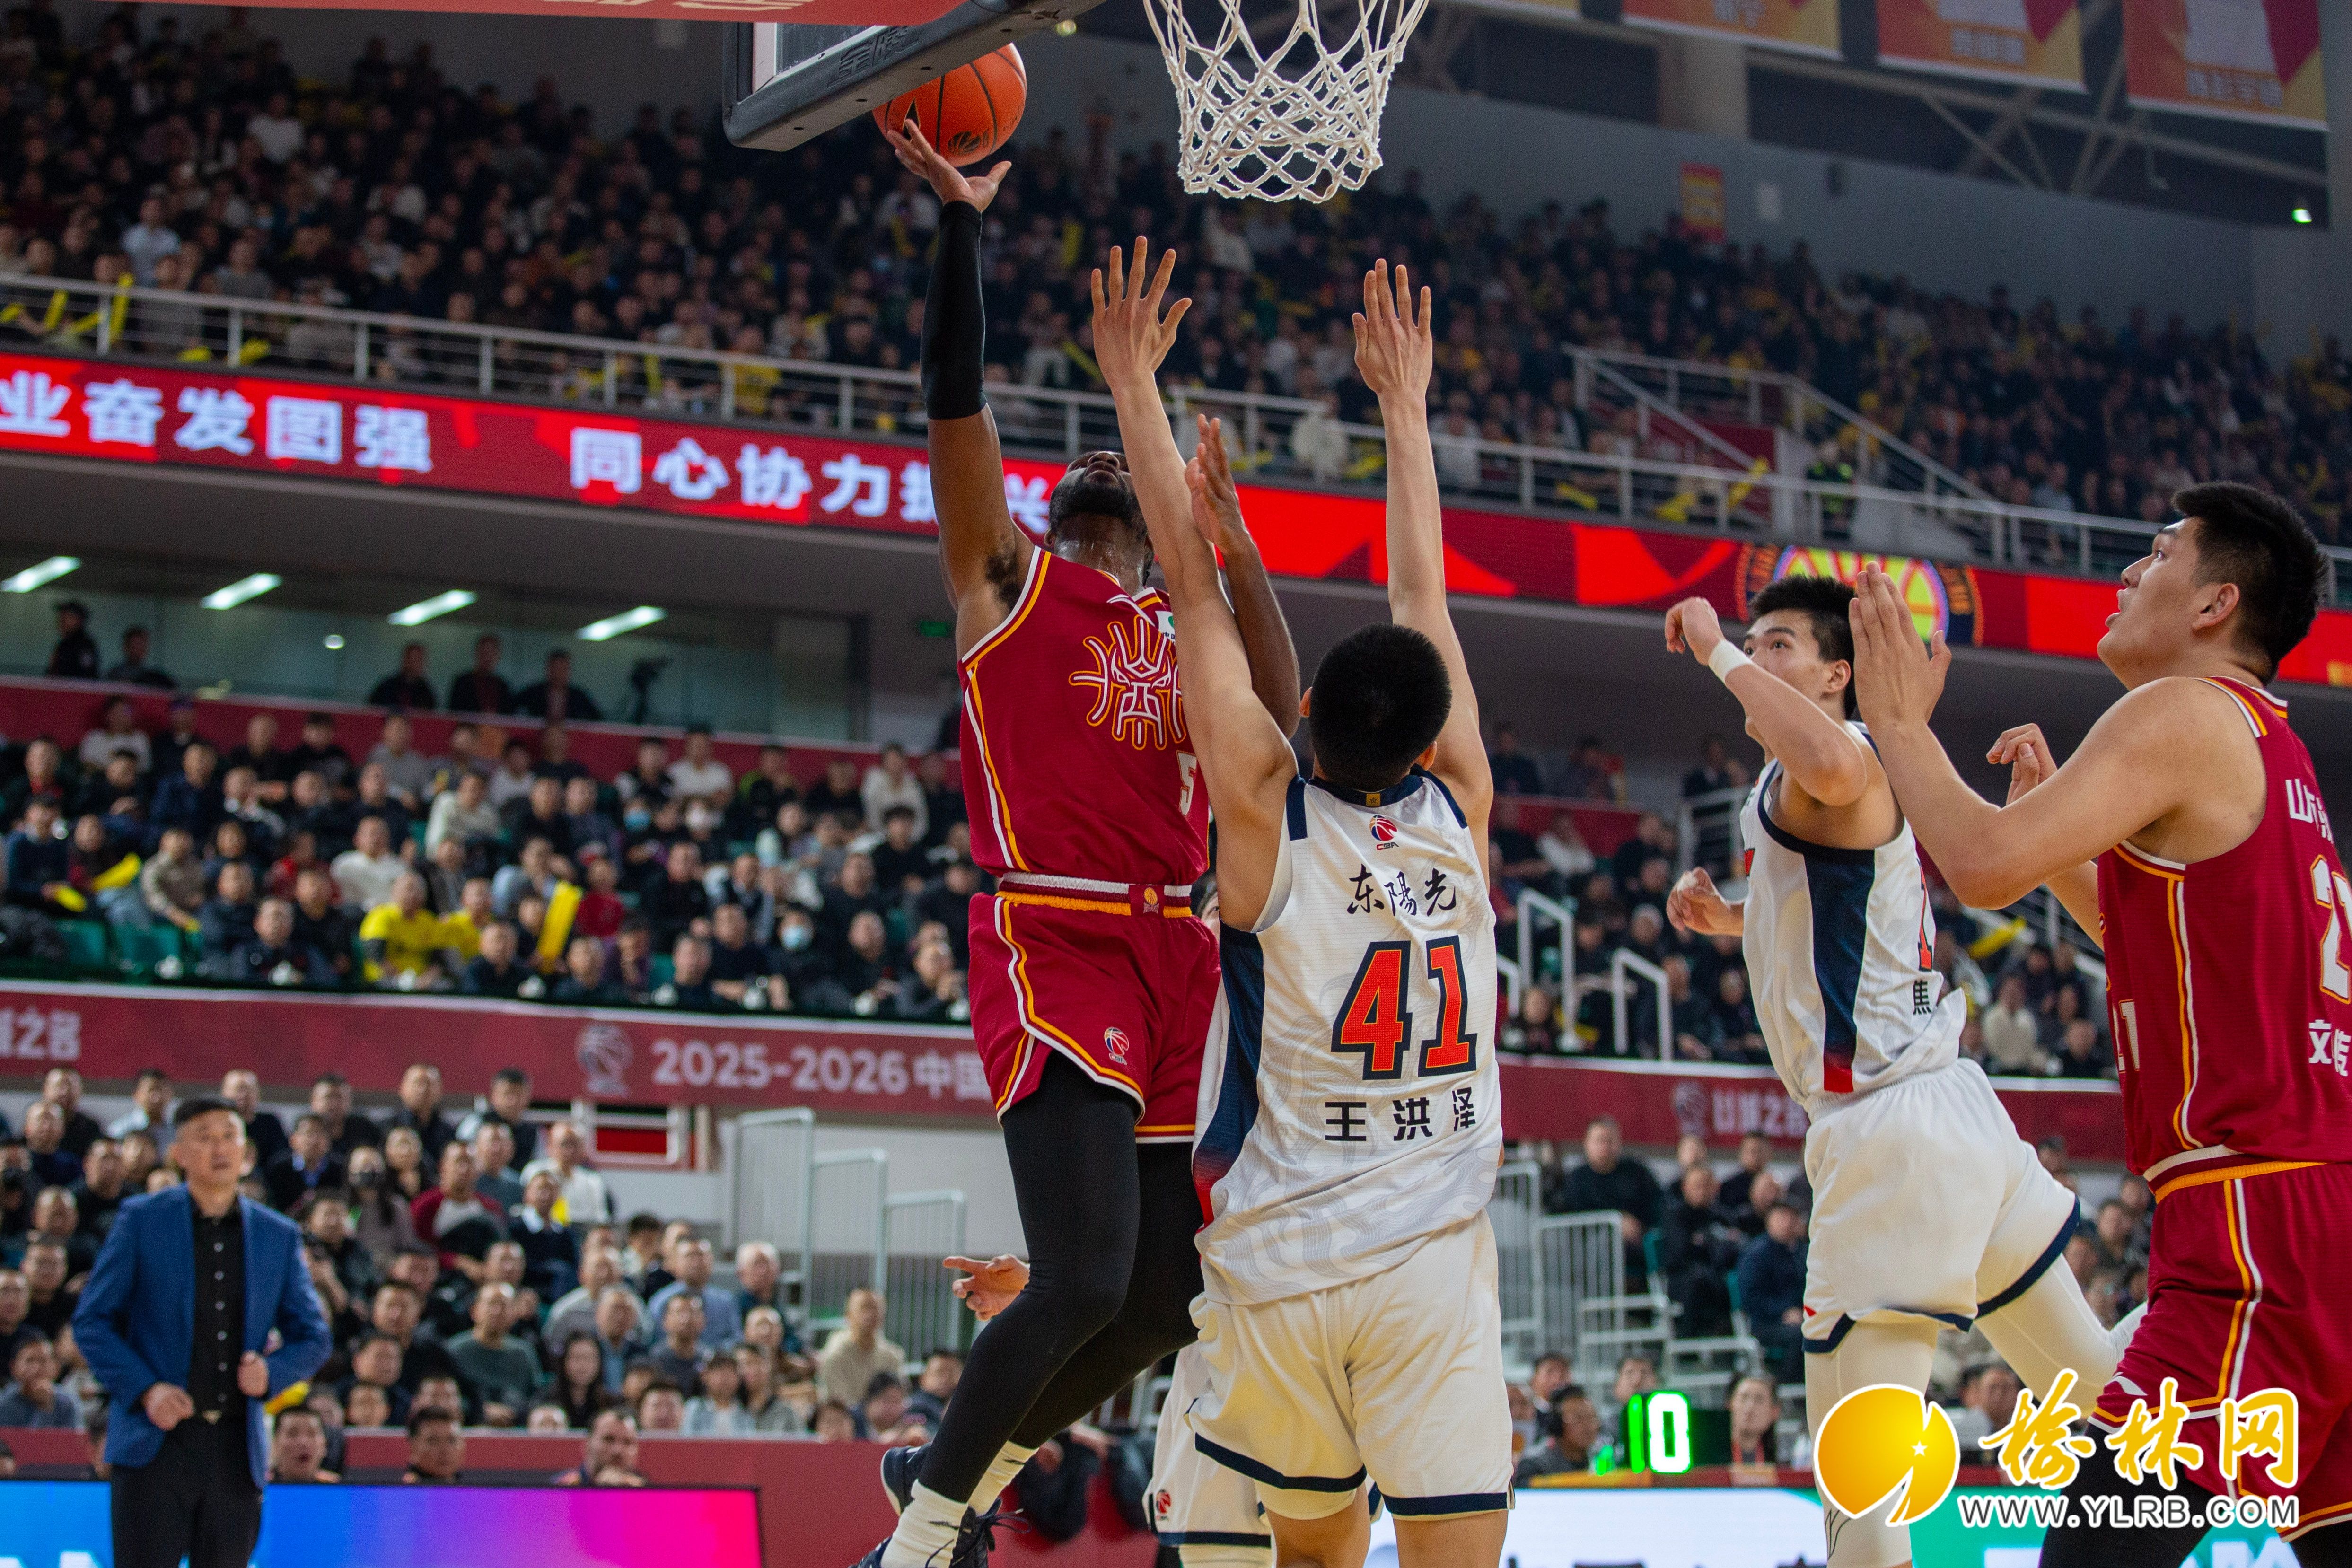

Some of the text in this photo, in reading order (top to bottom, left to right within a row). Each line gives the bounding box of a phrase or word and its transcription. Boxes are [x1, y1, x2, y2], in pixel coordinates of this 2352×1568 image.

[1377, 842, 1399, 850] CBA
[1331, 935, 1476, 1080] 41
[1325, 1087, 1476, 1141] 王洪泽
